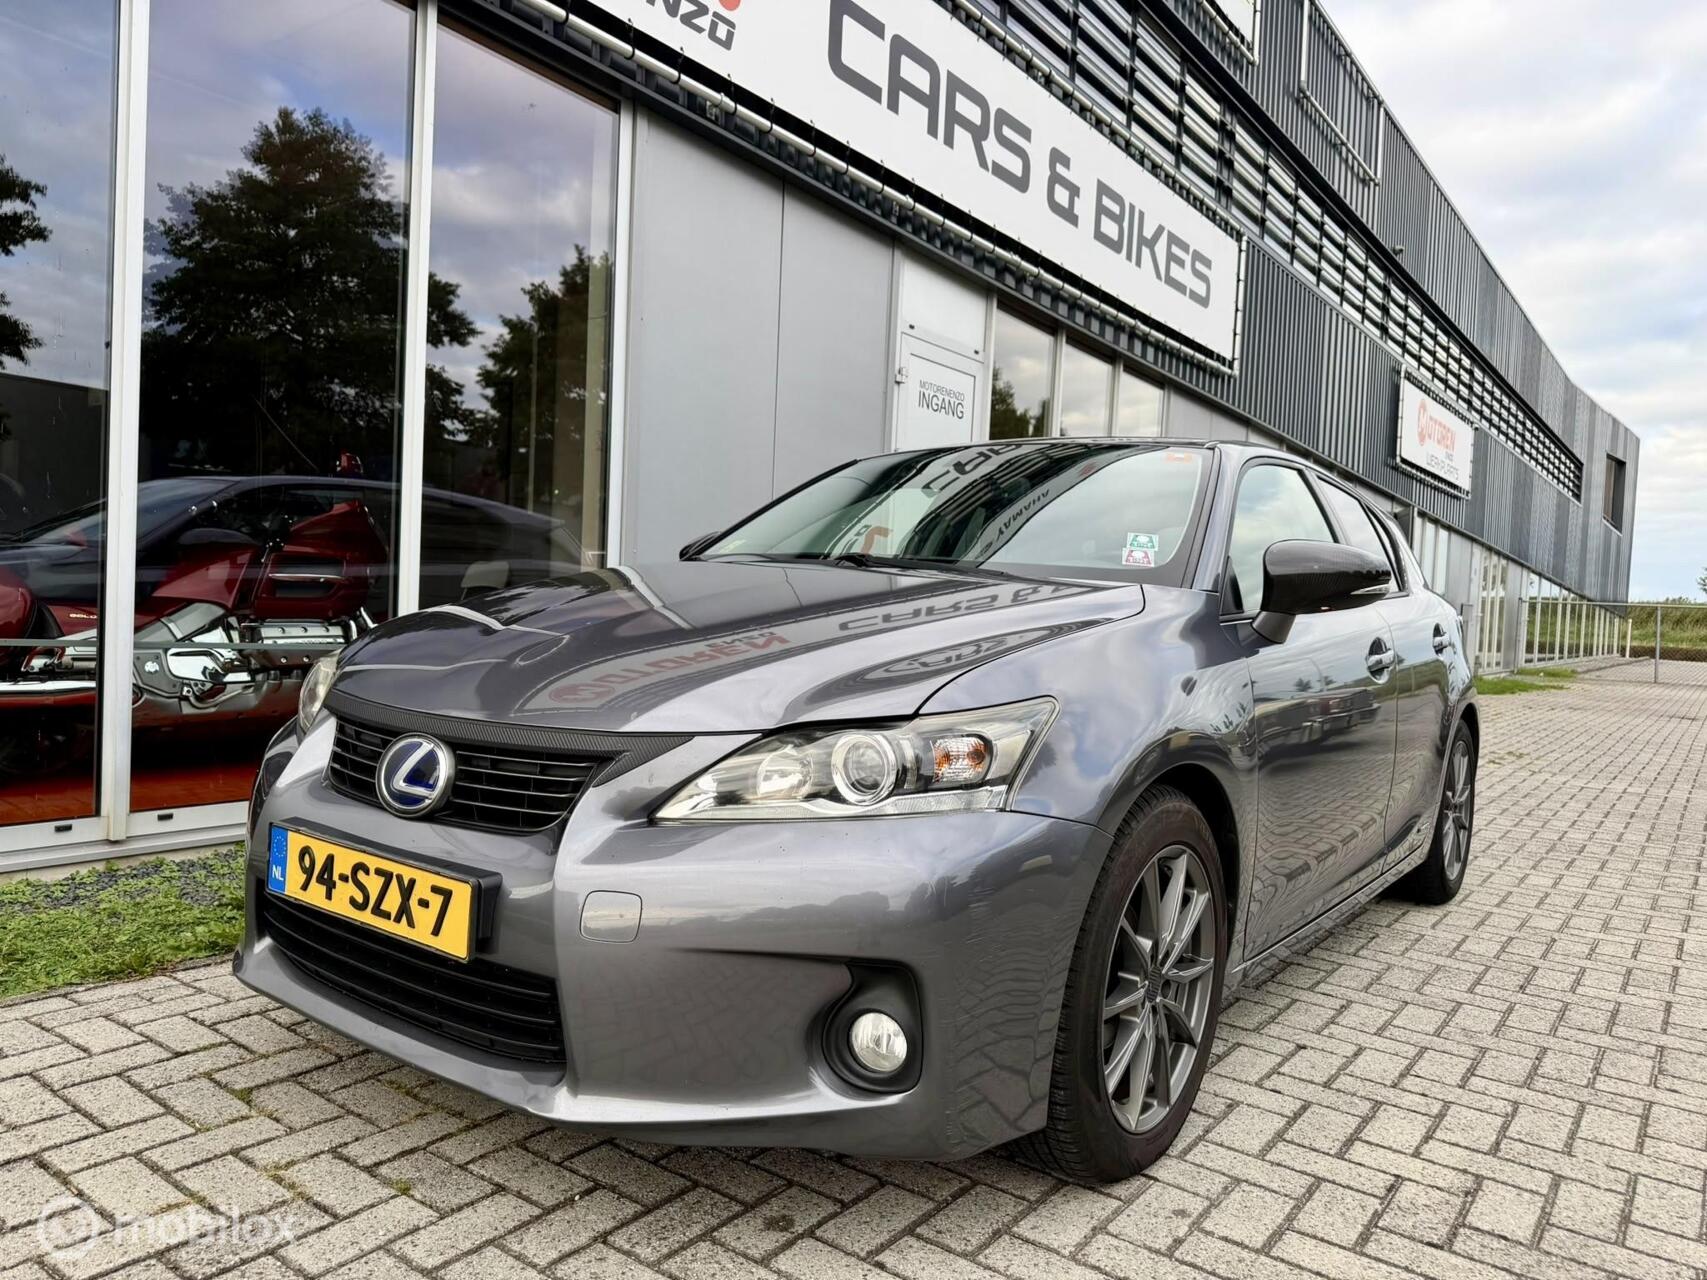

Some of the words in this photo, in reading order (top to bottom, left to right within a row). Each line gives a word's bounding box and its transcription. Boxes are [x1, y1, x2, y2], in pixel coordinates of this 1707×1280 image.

[828, 0, 1032, 194] CARS
[1047, 146, 1080, 229] &
[1094, 178, 1212, 309] BIKES
[918, 389, 965, 420] INGANG
[271, 864, 285, 882] NL
[298, 845, 453, 937] 94-SZX-7
